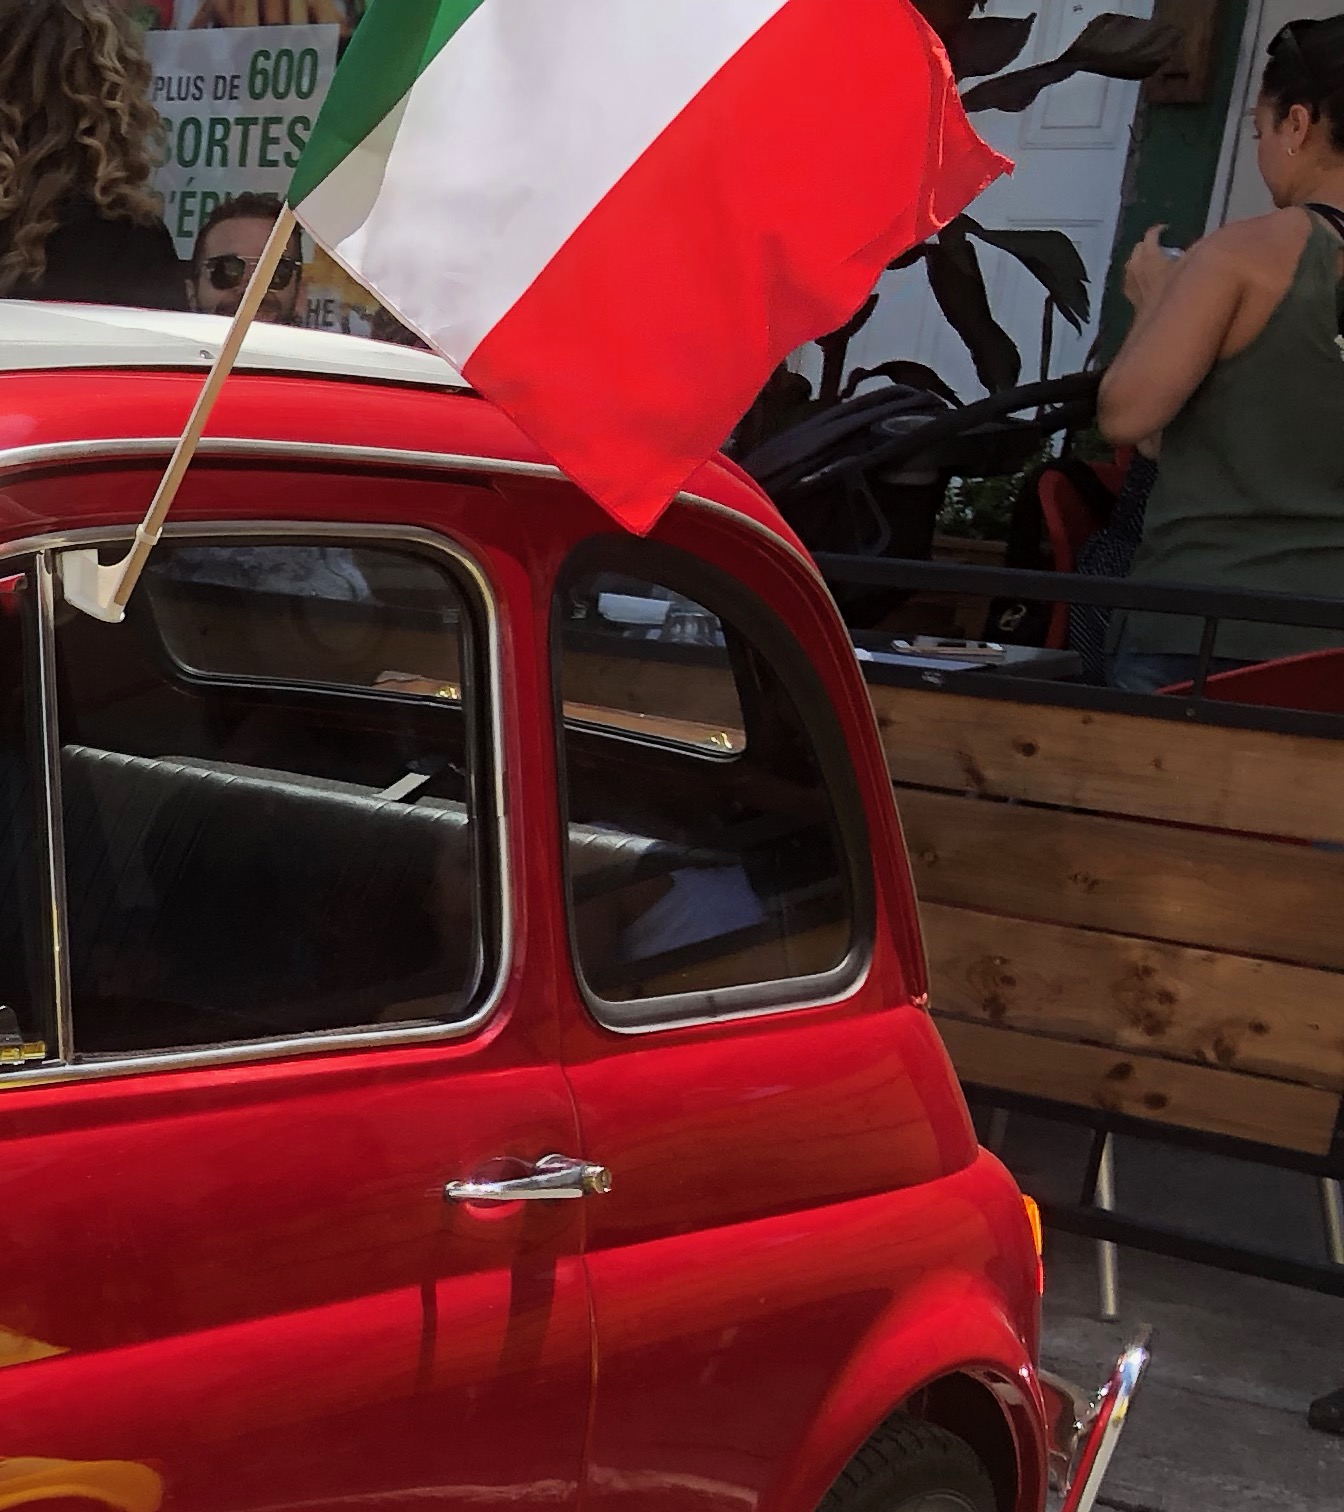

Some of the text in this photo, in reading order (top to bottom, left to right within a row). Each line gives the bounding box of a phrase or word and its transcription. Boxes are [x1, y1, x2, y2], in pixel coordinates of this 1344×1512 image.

[153, 48, 318, 101] PLUS DE 600
